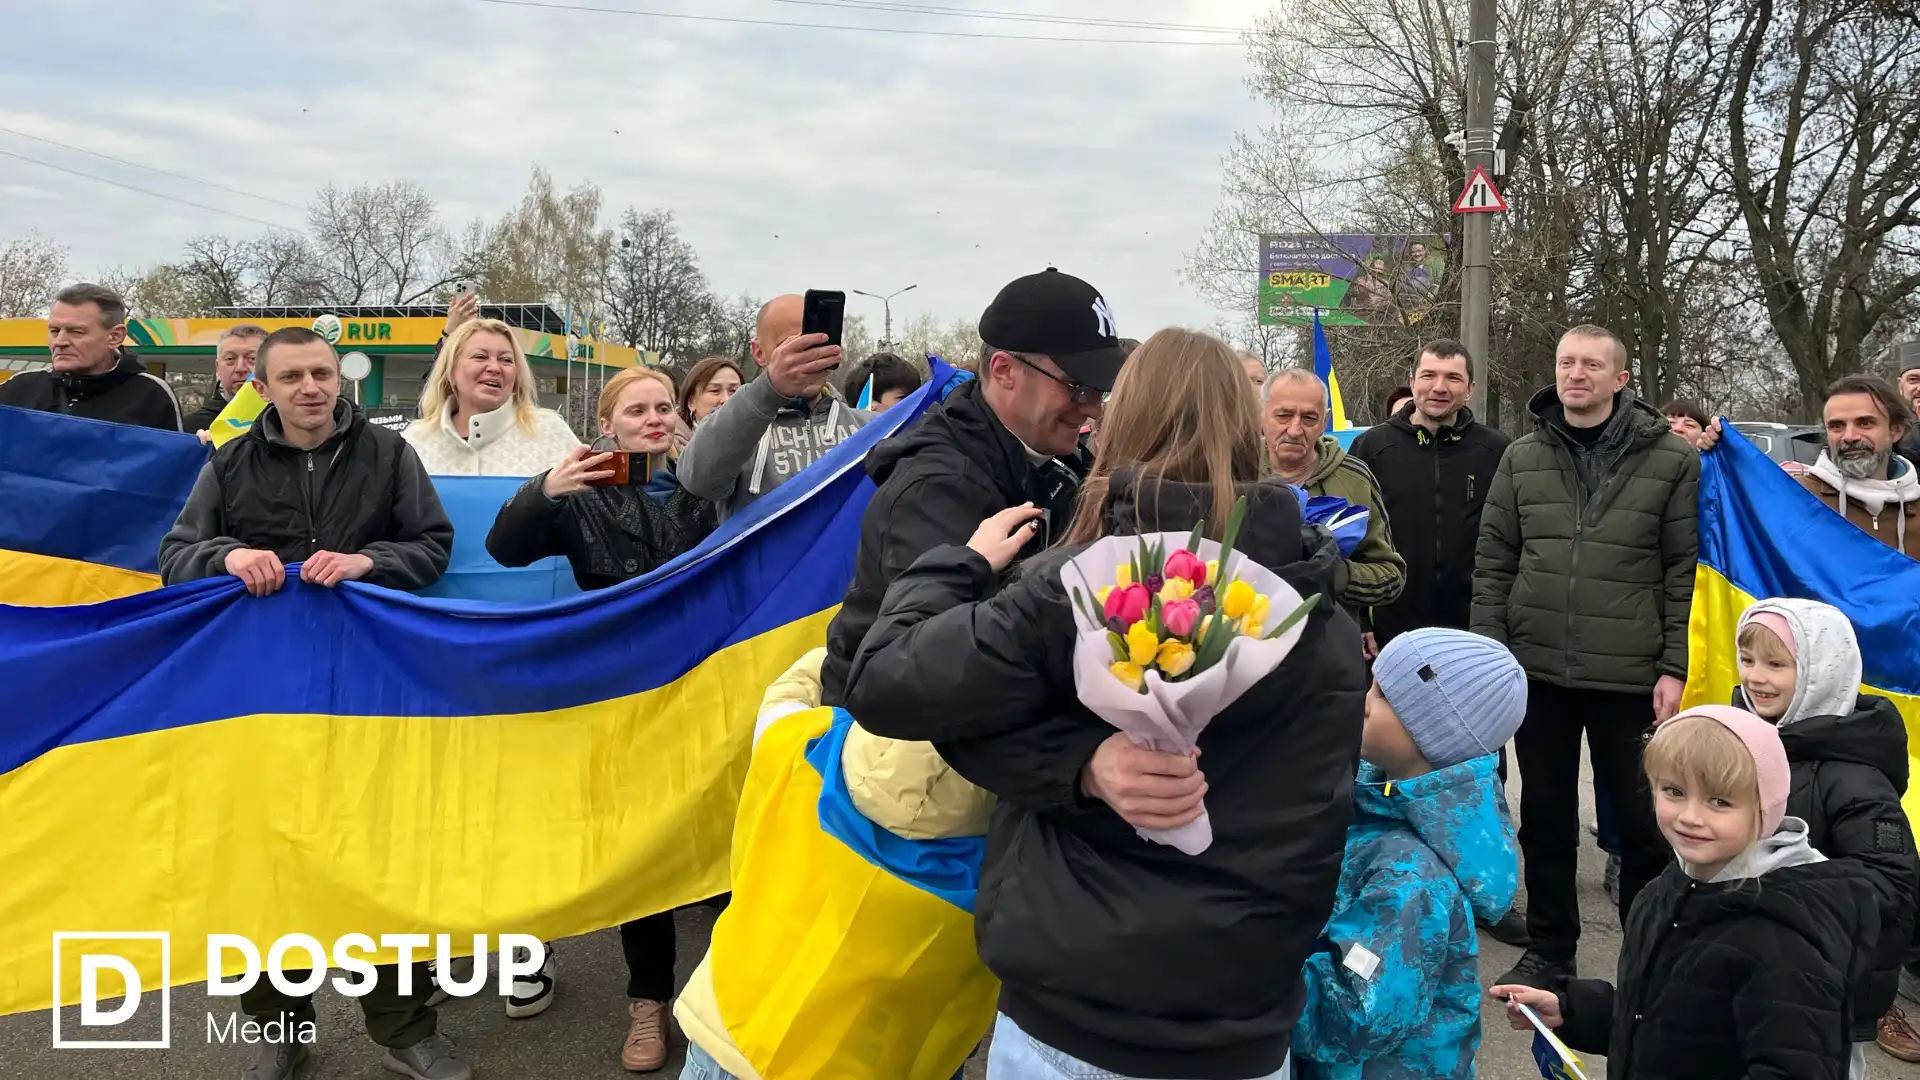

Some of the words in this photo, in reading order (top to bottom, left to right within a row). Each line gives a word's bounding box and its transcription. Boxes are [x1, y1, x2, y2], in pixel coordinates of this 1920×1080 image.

[1271, 275, 1328, 285] SMART
[348, 322, 391, 340] RUR
[774, 448, 833, 475] STA
